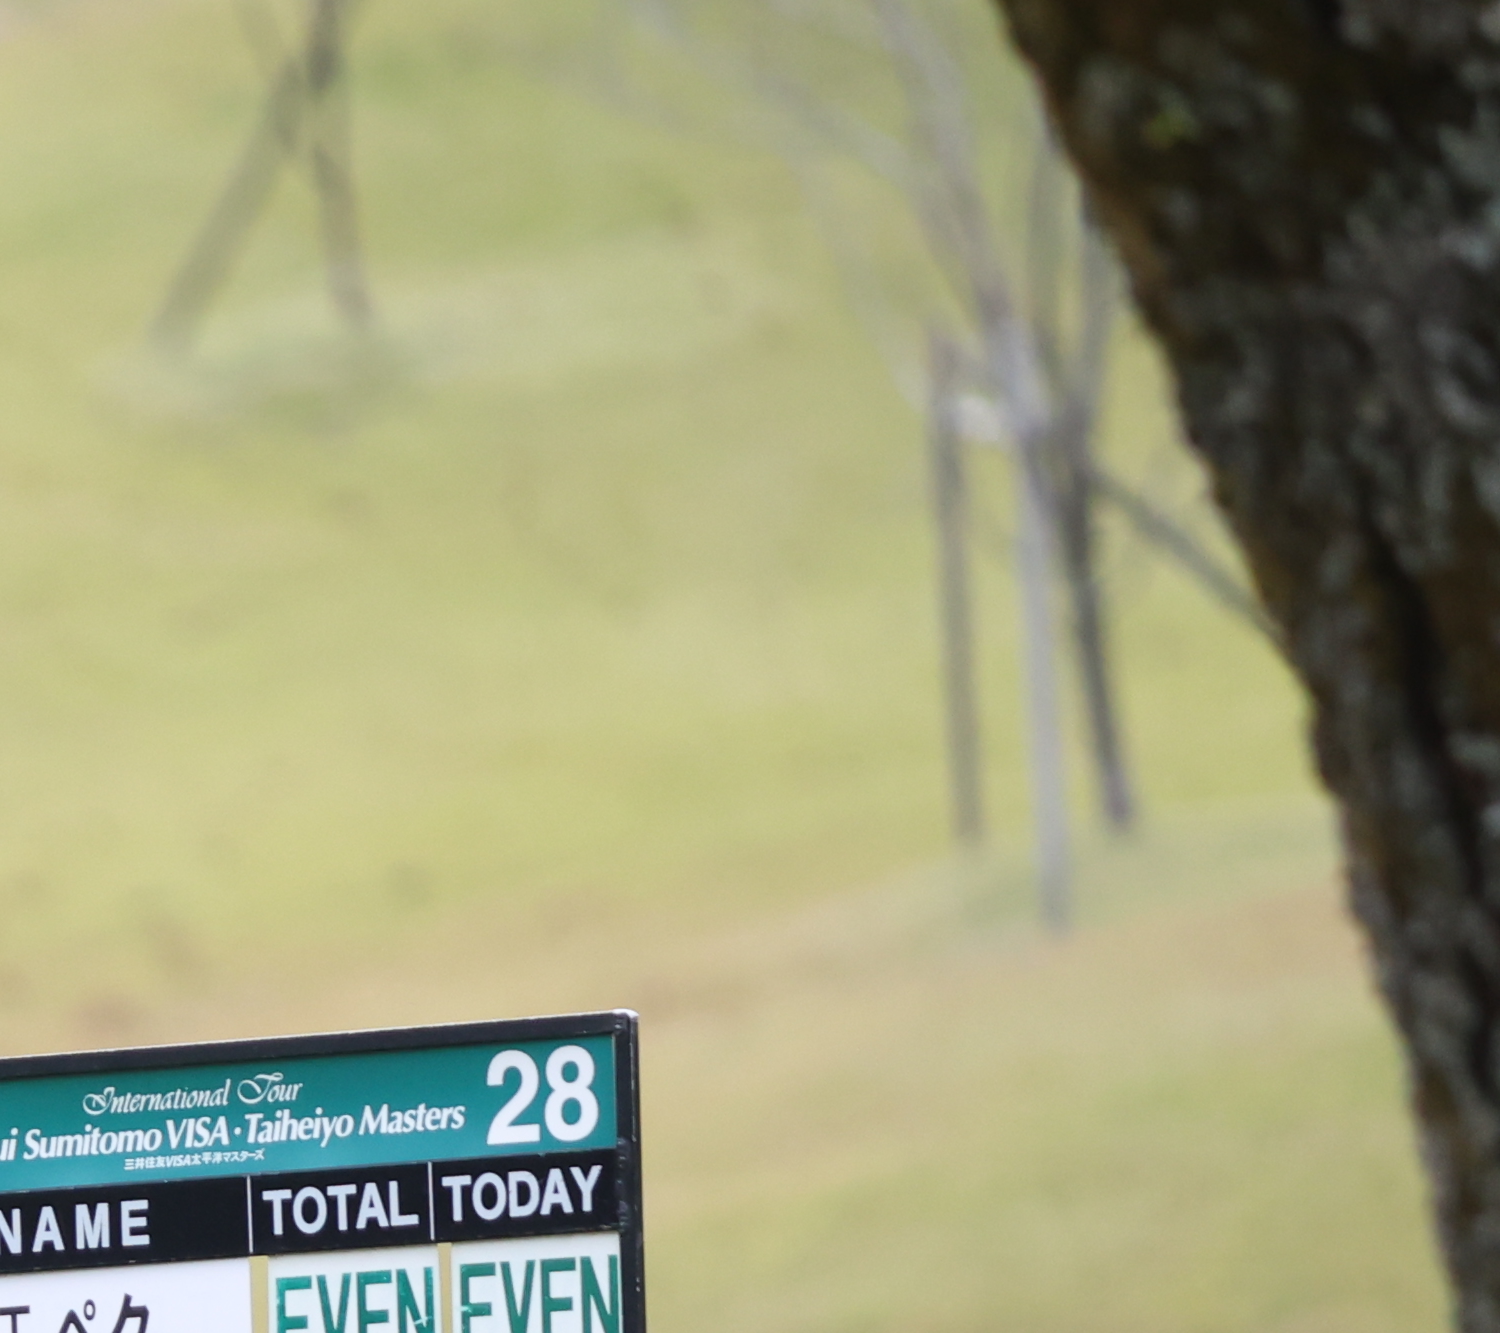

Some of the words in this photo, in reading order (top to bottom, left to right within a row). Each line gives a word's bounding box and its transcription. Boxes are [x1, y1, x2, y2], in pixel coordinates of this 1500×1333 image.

[82, 1078, 231, 1116] International
[237, 1072, 303, 1105] Tour
[485, 1044, 601, 1146] 28
[22, 1123, 163, 1161] Sumitomo
[357, 1102, 466, 1136] Masters
[124, 1147, 266, 1171] 三井住友VISA太平洋マスターズ
[262, 1181, 421, 1237] TOTAL
[441, 1165, 604, 1222] TODAY
